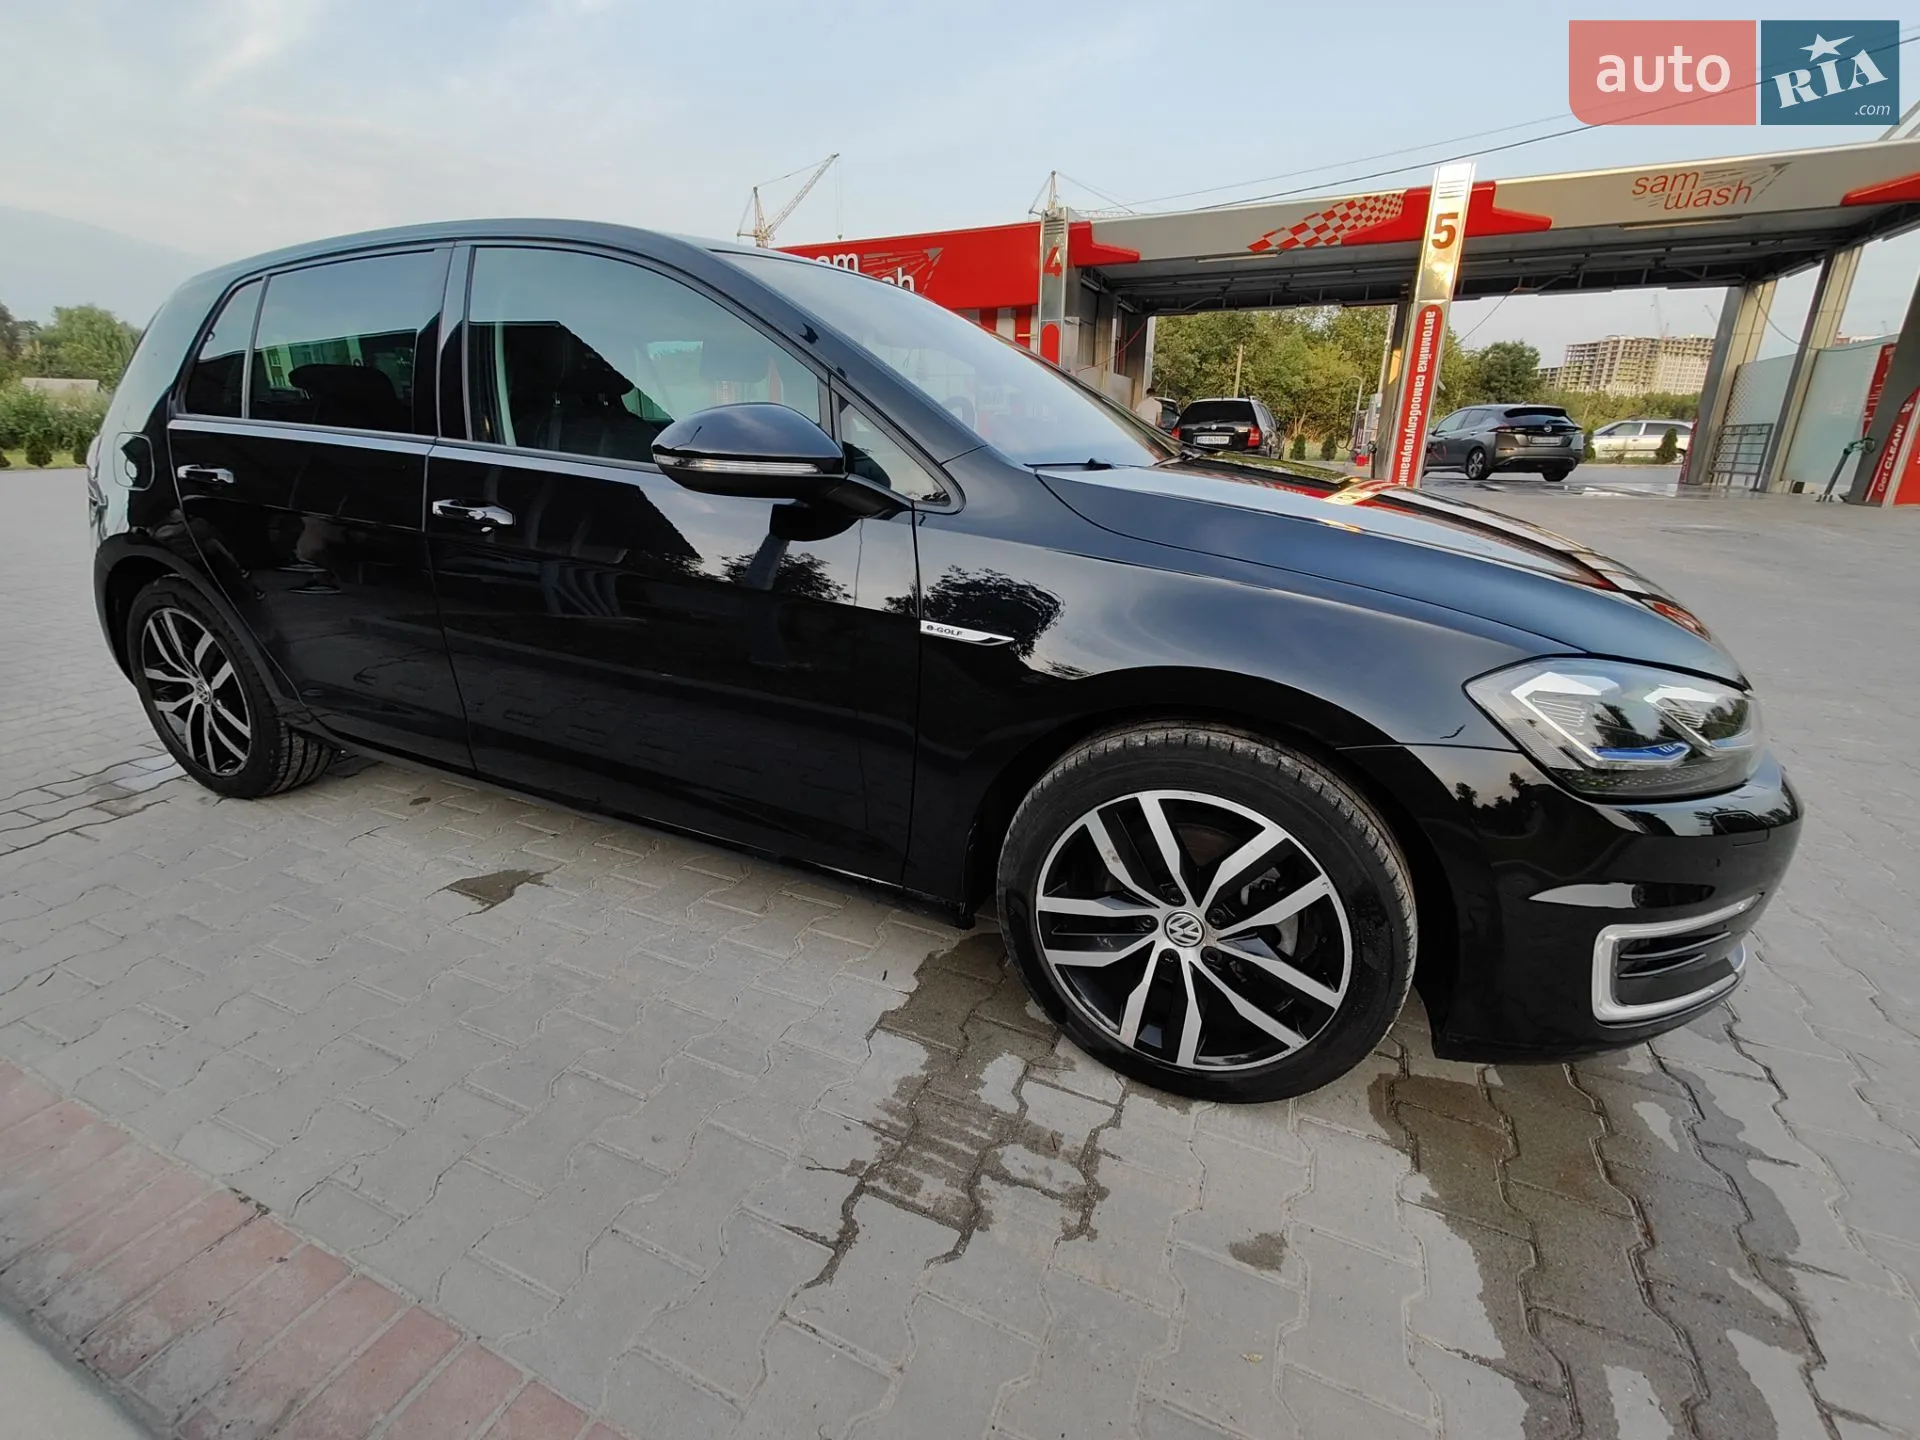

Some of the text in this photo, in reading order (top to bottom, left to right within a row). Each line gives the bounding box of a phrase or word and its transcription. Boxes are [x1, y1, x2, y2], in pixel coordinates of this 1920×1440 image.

[1631, 171, 1700, 196] sam
[1663, 179, 1752, 210] wash
[1431, 212, 1459, 249] 5
[1043, 245, 1063, 277] 4
[1417, 311, 1436, 373] автомийка
